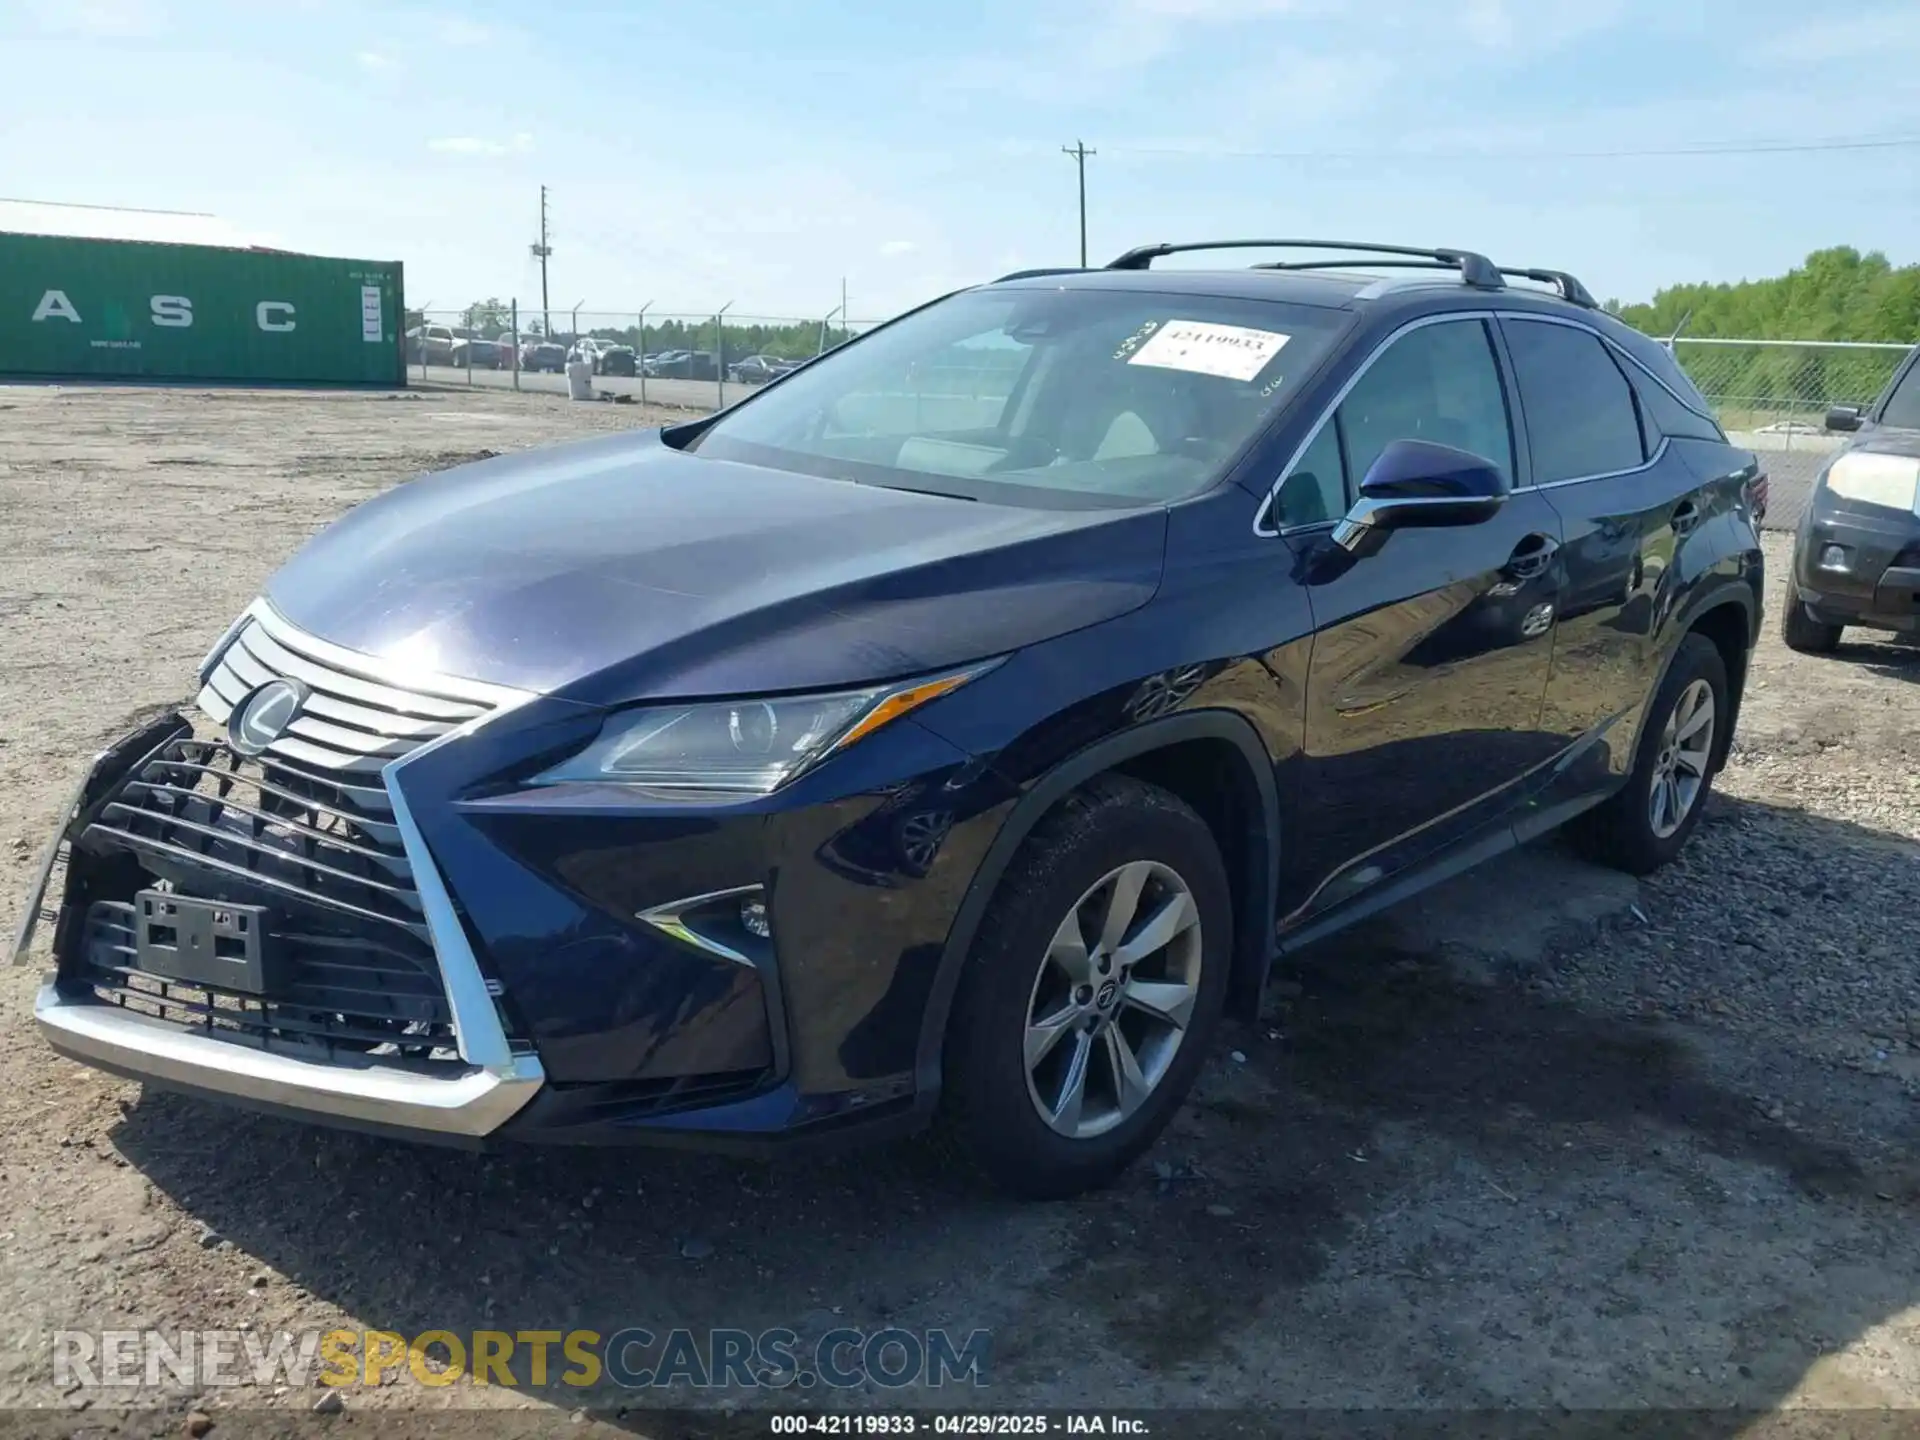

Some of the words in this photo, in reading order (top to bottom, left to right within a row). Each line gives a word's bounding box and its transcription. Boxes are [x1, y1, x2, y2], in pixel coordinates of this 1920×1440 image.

[32, 289, 82, 323] A
[150, 294, 193, 327] S
[256, 300, 296, 333] C
